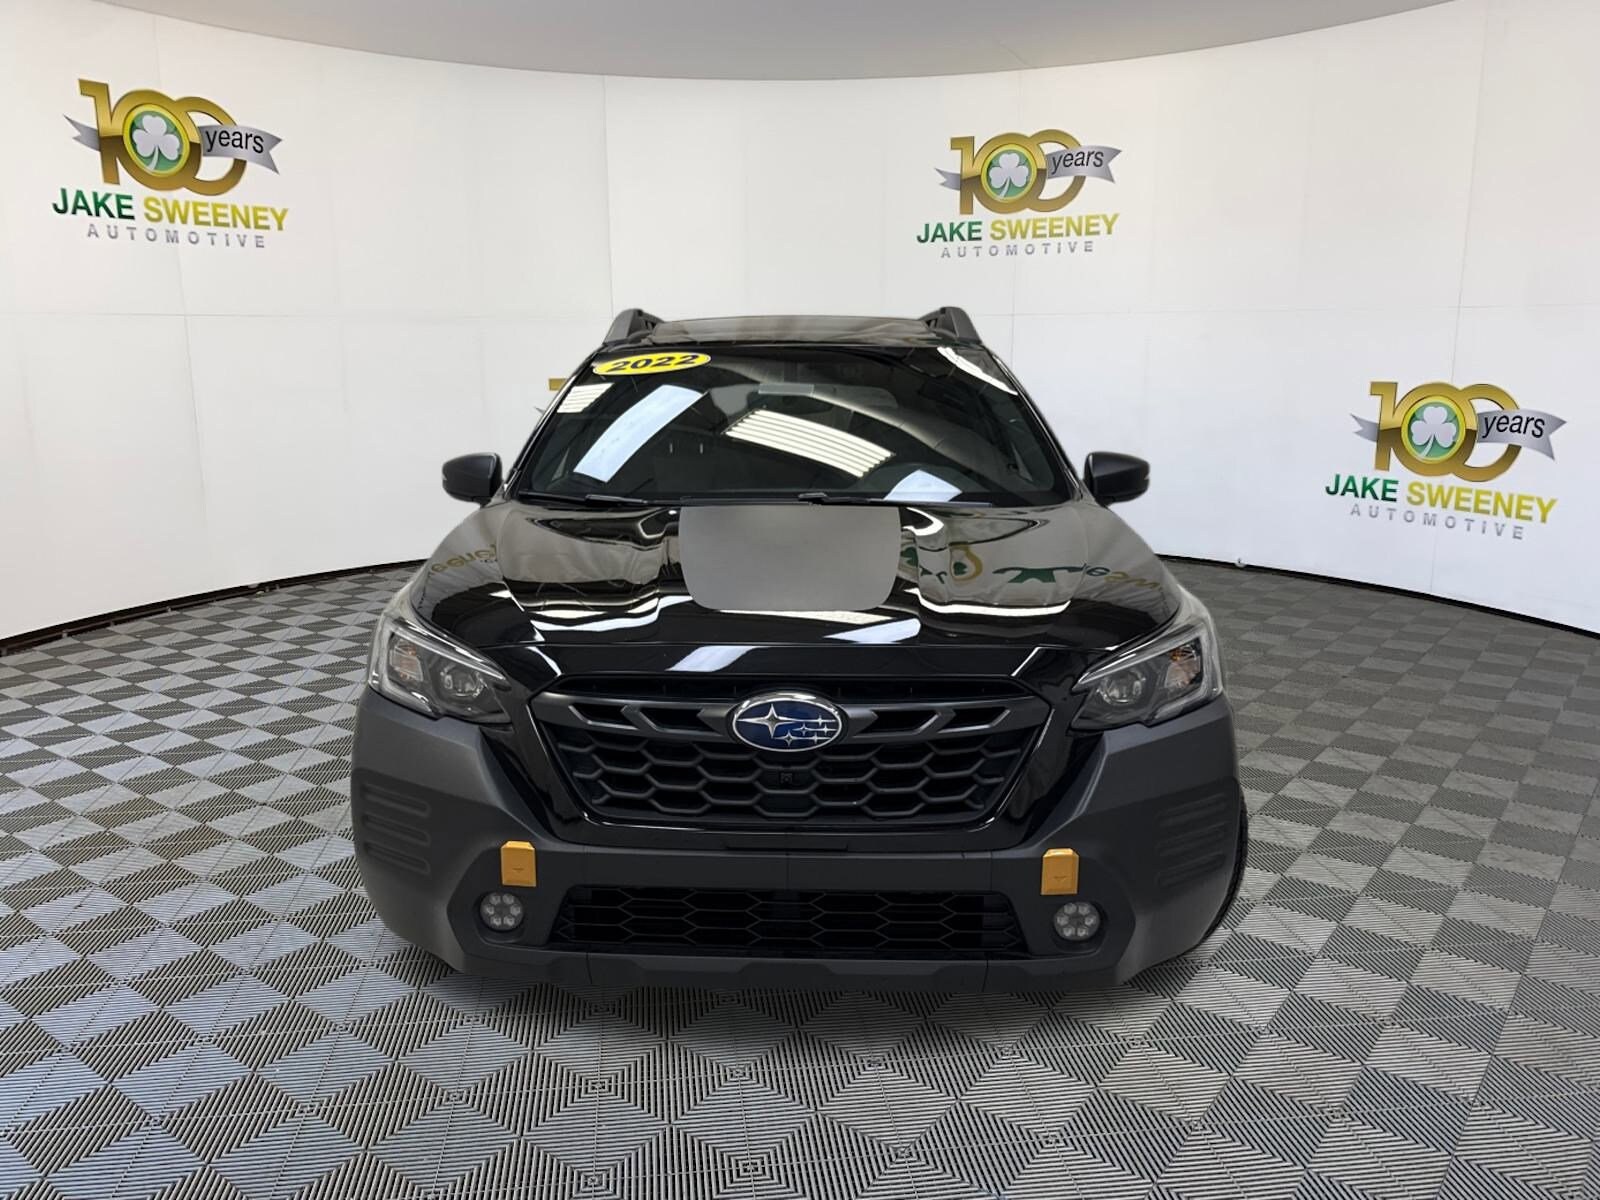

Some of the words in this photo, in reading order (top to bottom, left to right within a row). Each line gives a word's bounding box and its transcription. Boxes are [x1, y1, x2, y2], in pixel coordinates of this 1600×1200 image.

[78, 78, 247, 197] 100
[205, 129, 265, 154] years
[950, 128, 1087, 215] 100
[1051, 149, 1104, 175] years
[52, 187, 135, 220] JAKE
[143, 196, 289, 231] SWEENEY
[916, 220, 983, 244] JAKE
[990, 213, 1120, 241] SWEENEY
[87, 223, 265, 249] AUTOMOTIVE
[940, 240, 1094, 259] AUTOMOTIVE
[605, 354, 699, 373] 2022
[1370, 381, 1522, 482] 100
[1481, 414, 1546, 439] years
[1325, 473, 1400, 503] JAKE
[1406, 480, 1558, 524] SWEENEY
[1350, 503, 1525, 541] AUTOMOTIVE
